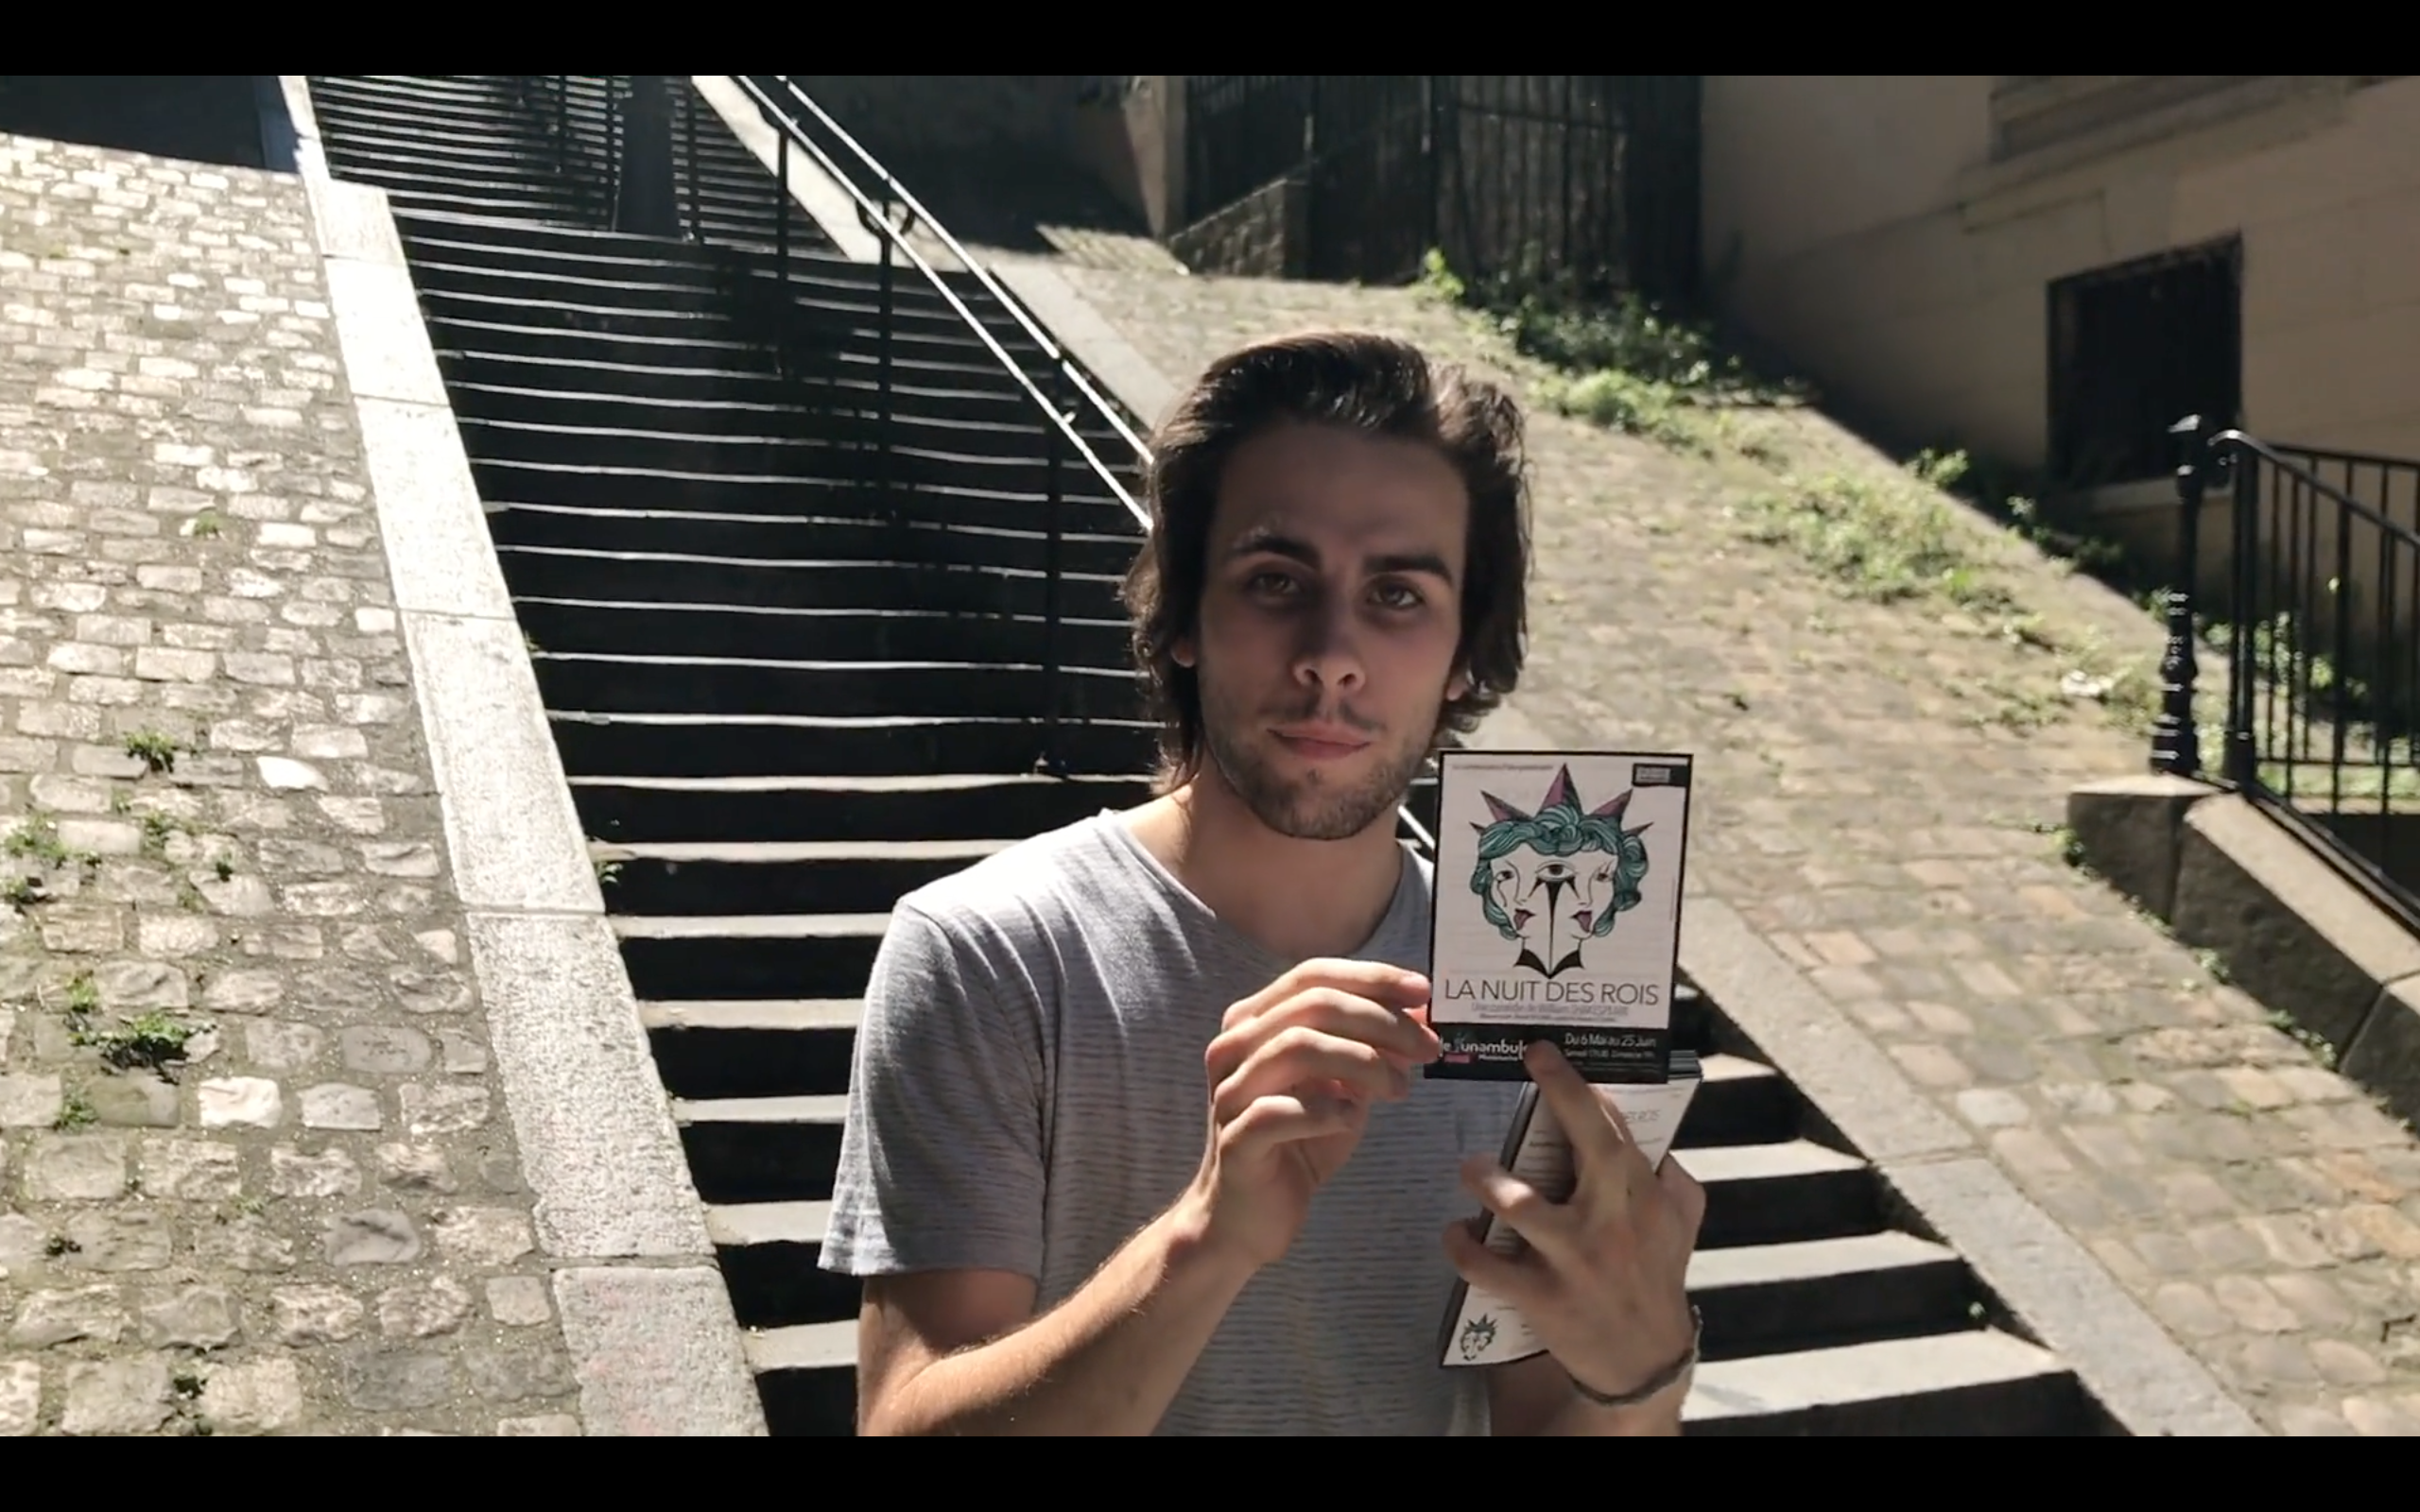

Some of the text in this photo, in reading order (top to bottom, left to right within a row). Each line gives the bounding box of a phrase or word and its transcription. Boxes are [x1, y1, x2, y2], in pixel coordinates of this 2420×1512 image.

[1444, 979, 1660, 1006] LA NUIT DES ROIS
[1564, 1032, 1580, 1045] Du
[1580, 1033, 1588, 1045] 6
